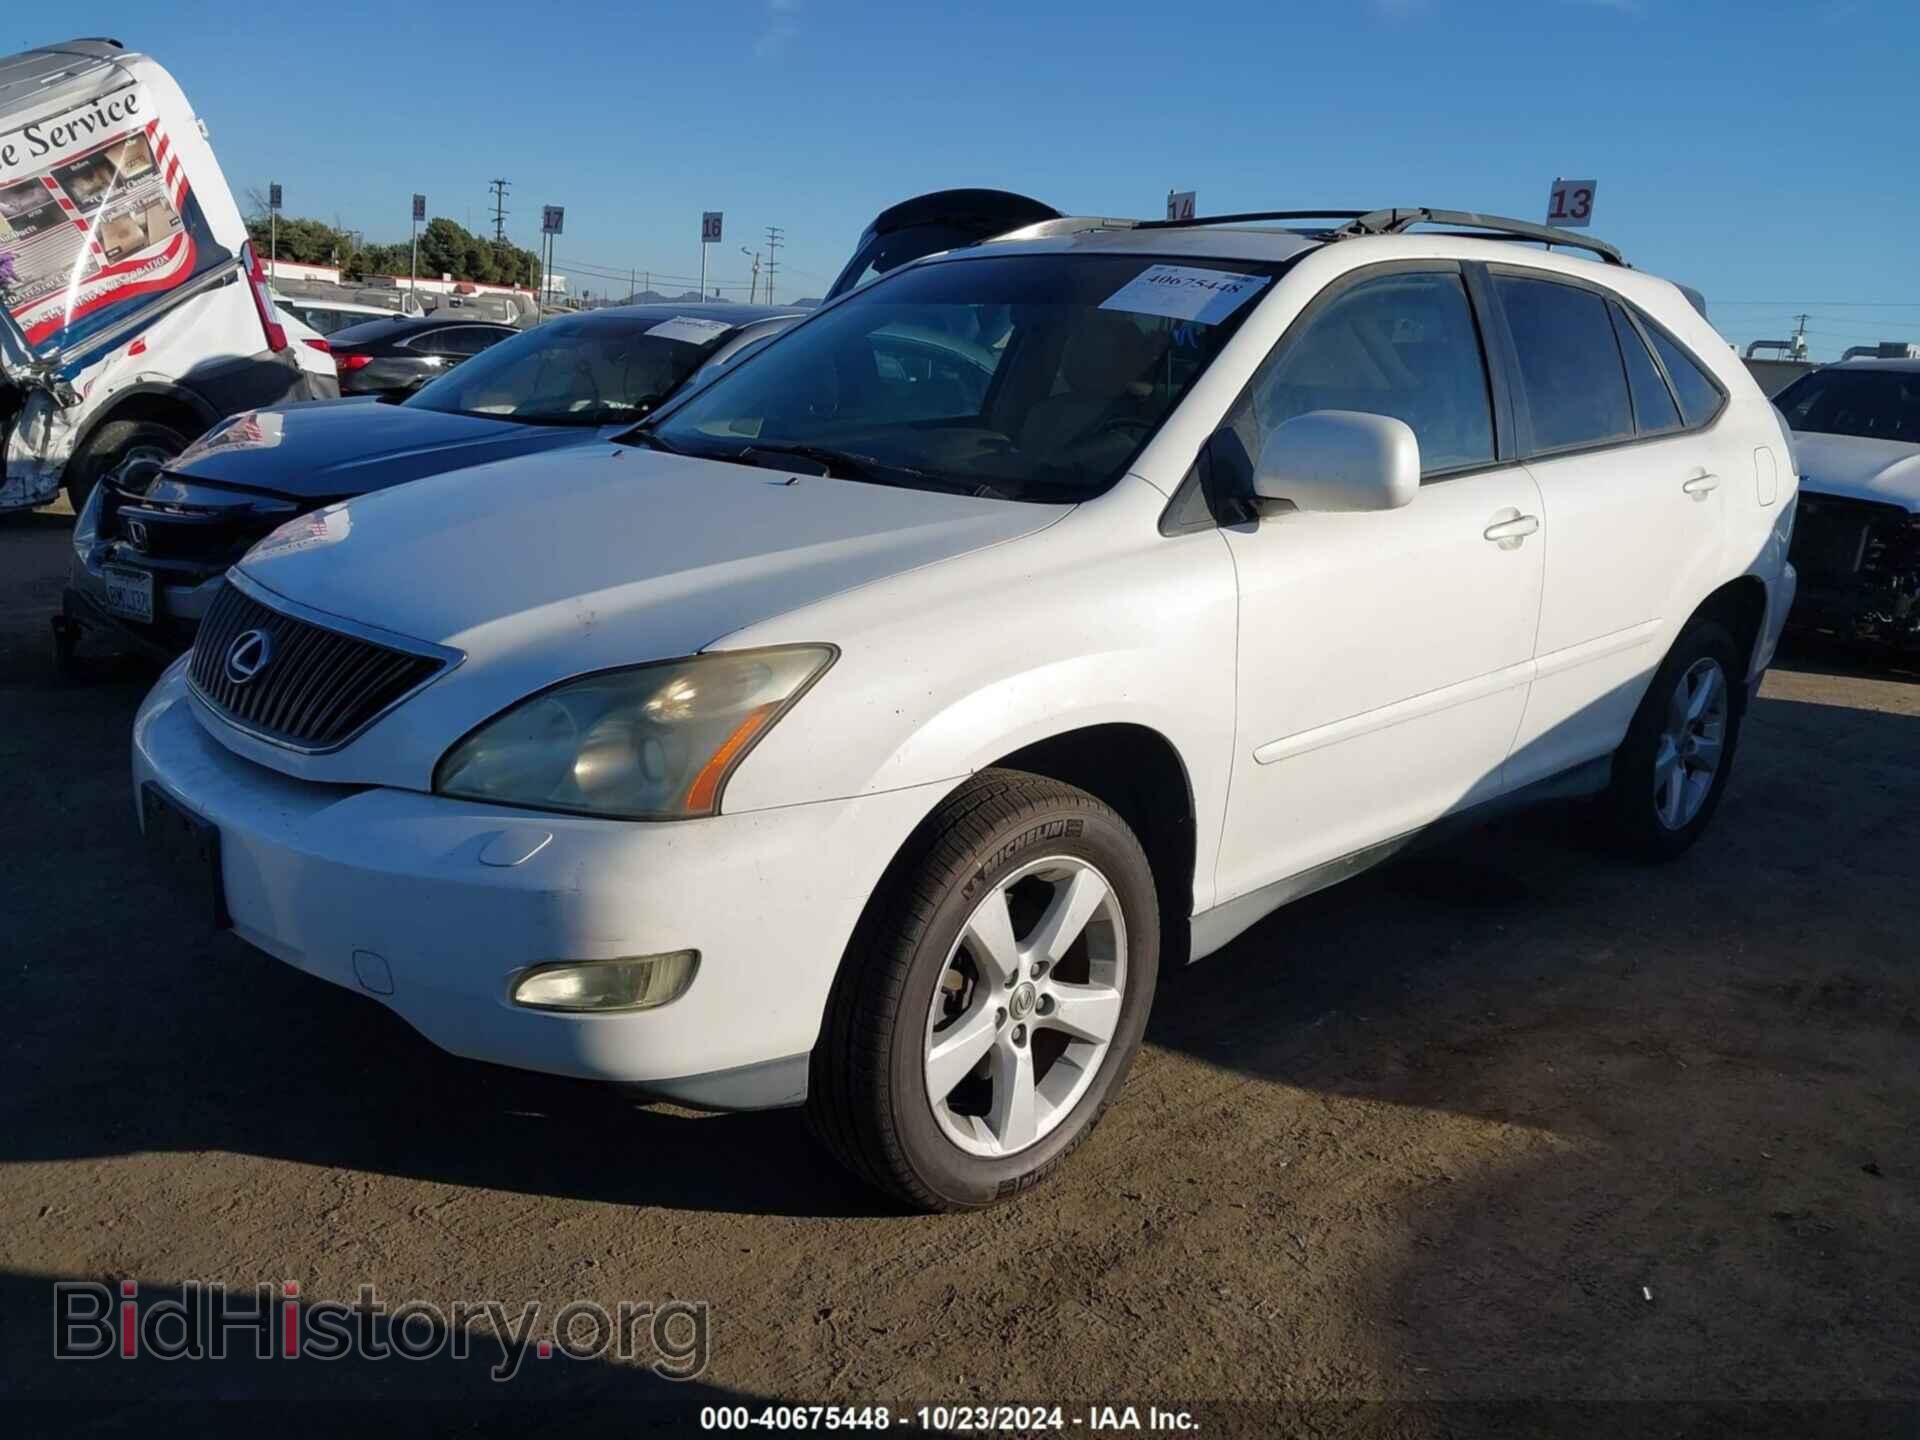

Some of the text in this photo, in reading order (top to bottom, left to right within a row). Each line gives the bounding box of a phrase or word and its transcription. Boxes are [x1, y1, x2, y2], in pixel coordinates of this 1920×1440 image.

[23, 94, 140, 157] Service
[1168, 199, 1194, 220] 14
[1550, 188, 1592, 218] 13
[543, 210, 564, 230] 17
[703, 217, 722, 239] 16
[1148, 273, 1244, 294] 40675448
[983, 819, 1065, 874] MICHELIN
